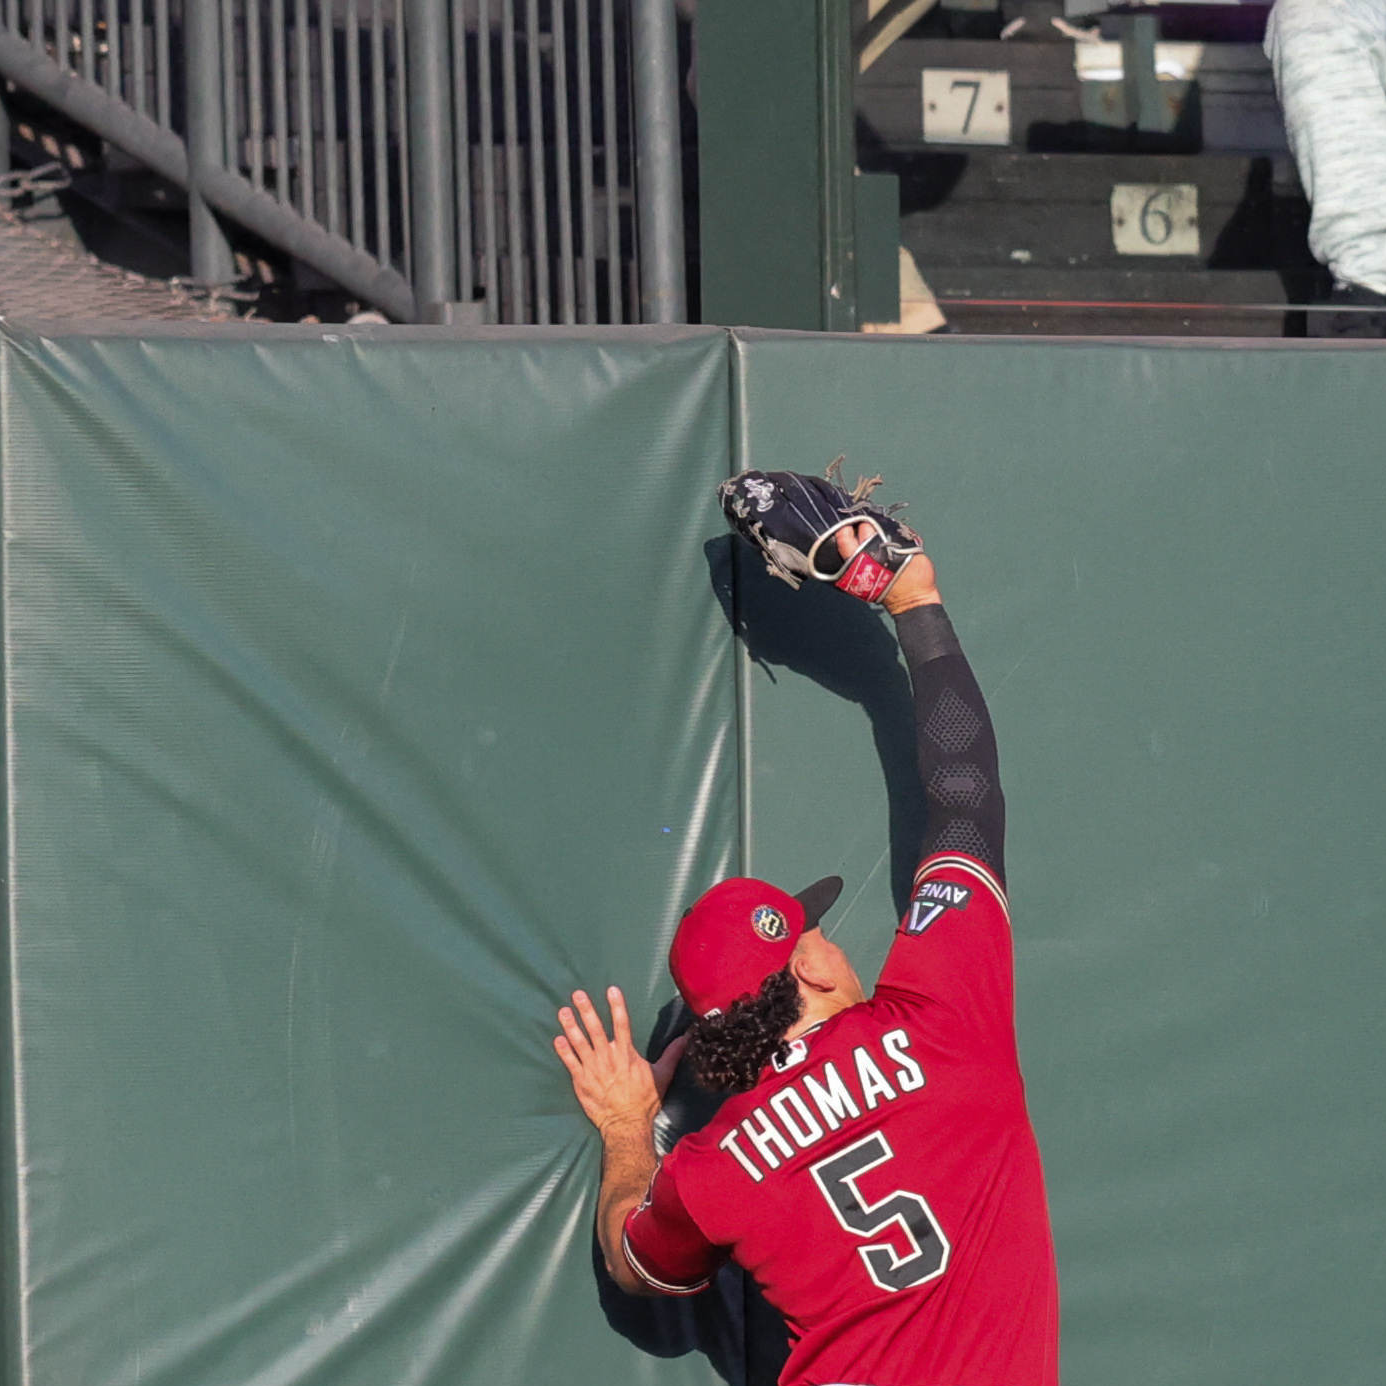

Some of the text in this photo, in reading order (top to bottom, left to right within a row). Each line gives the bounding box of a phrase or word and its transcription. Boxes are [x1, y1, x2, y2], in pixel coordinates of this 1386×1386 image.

[950, 81, 982, 135] 7
[1140, 185, 1180, 246] 6
[916, 883, 968, 904] AVNE
[717, 1028, 926, 1183] THOMAS
[808, 1129, 951, 1293] 5
